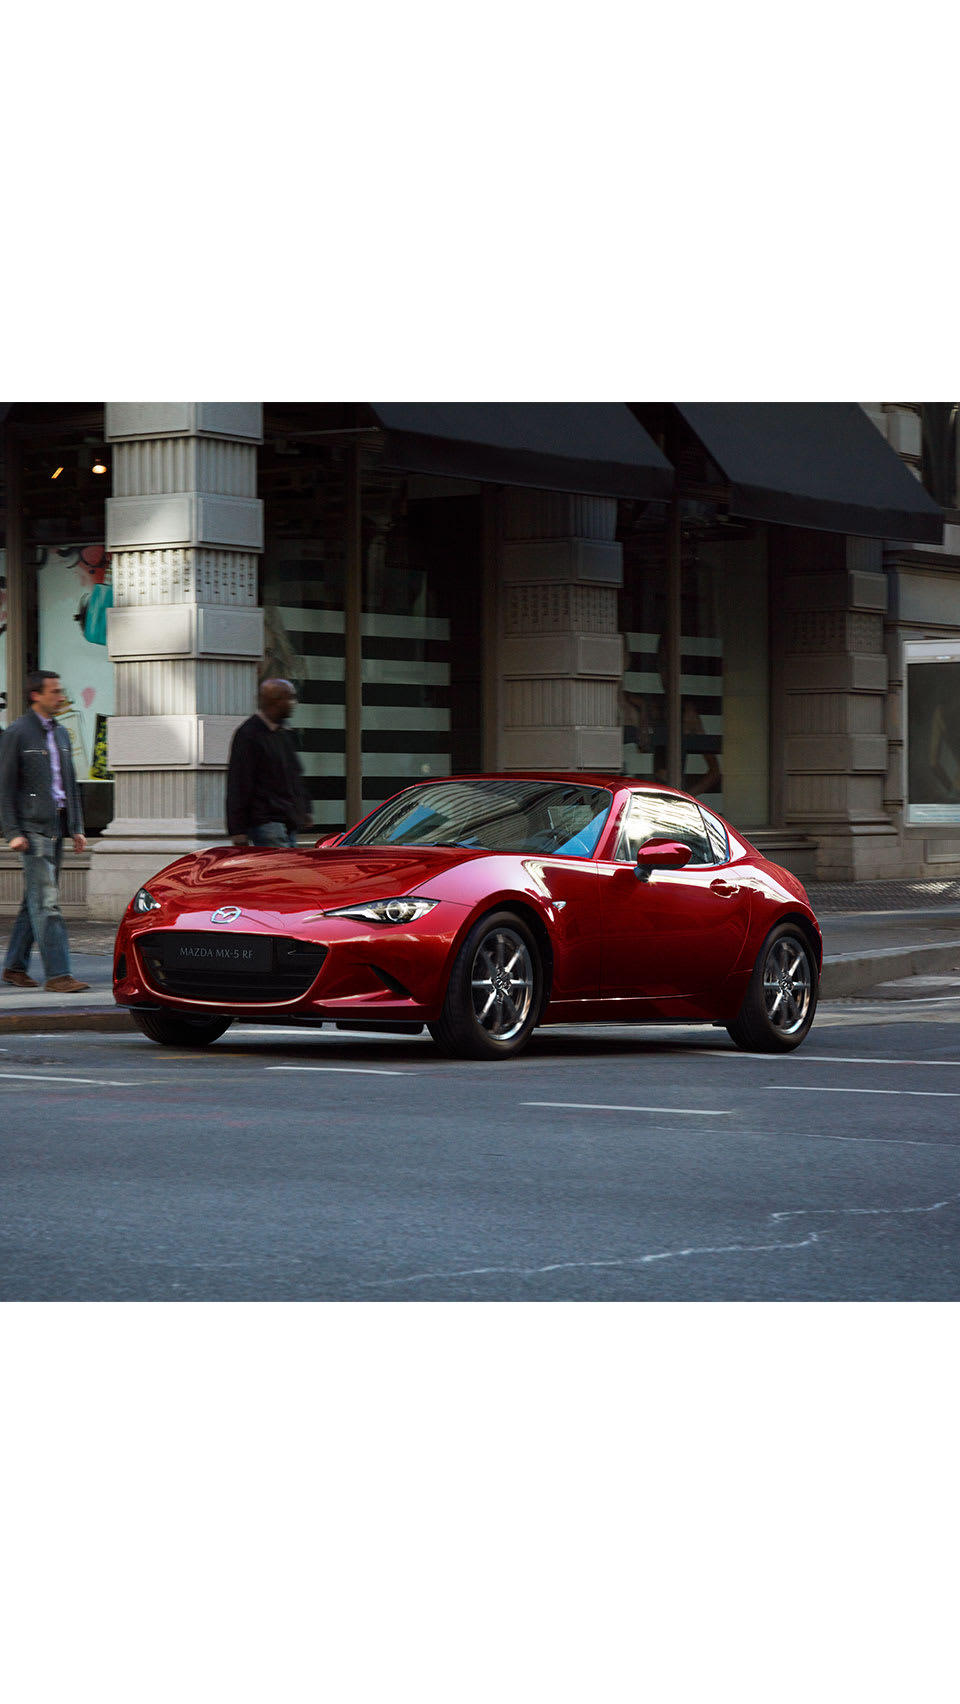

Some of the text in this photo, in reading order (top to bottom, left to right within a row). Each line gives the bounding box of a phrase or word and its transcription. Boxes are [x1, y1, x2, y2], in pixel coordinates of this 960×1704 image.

[180, 947, 253, 959] MAZDA MX-5 RF
